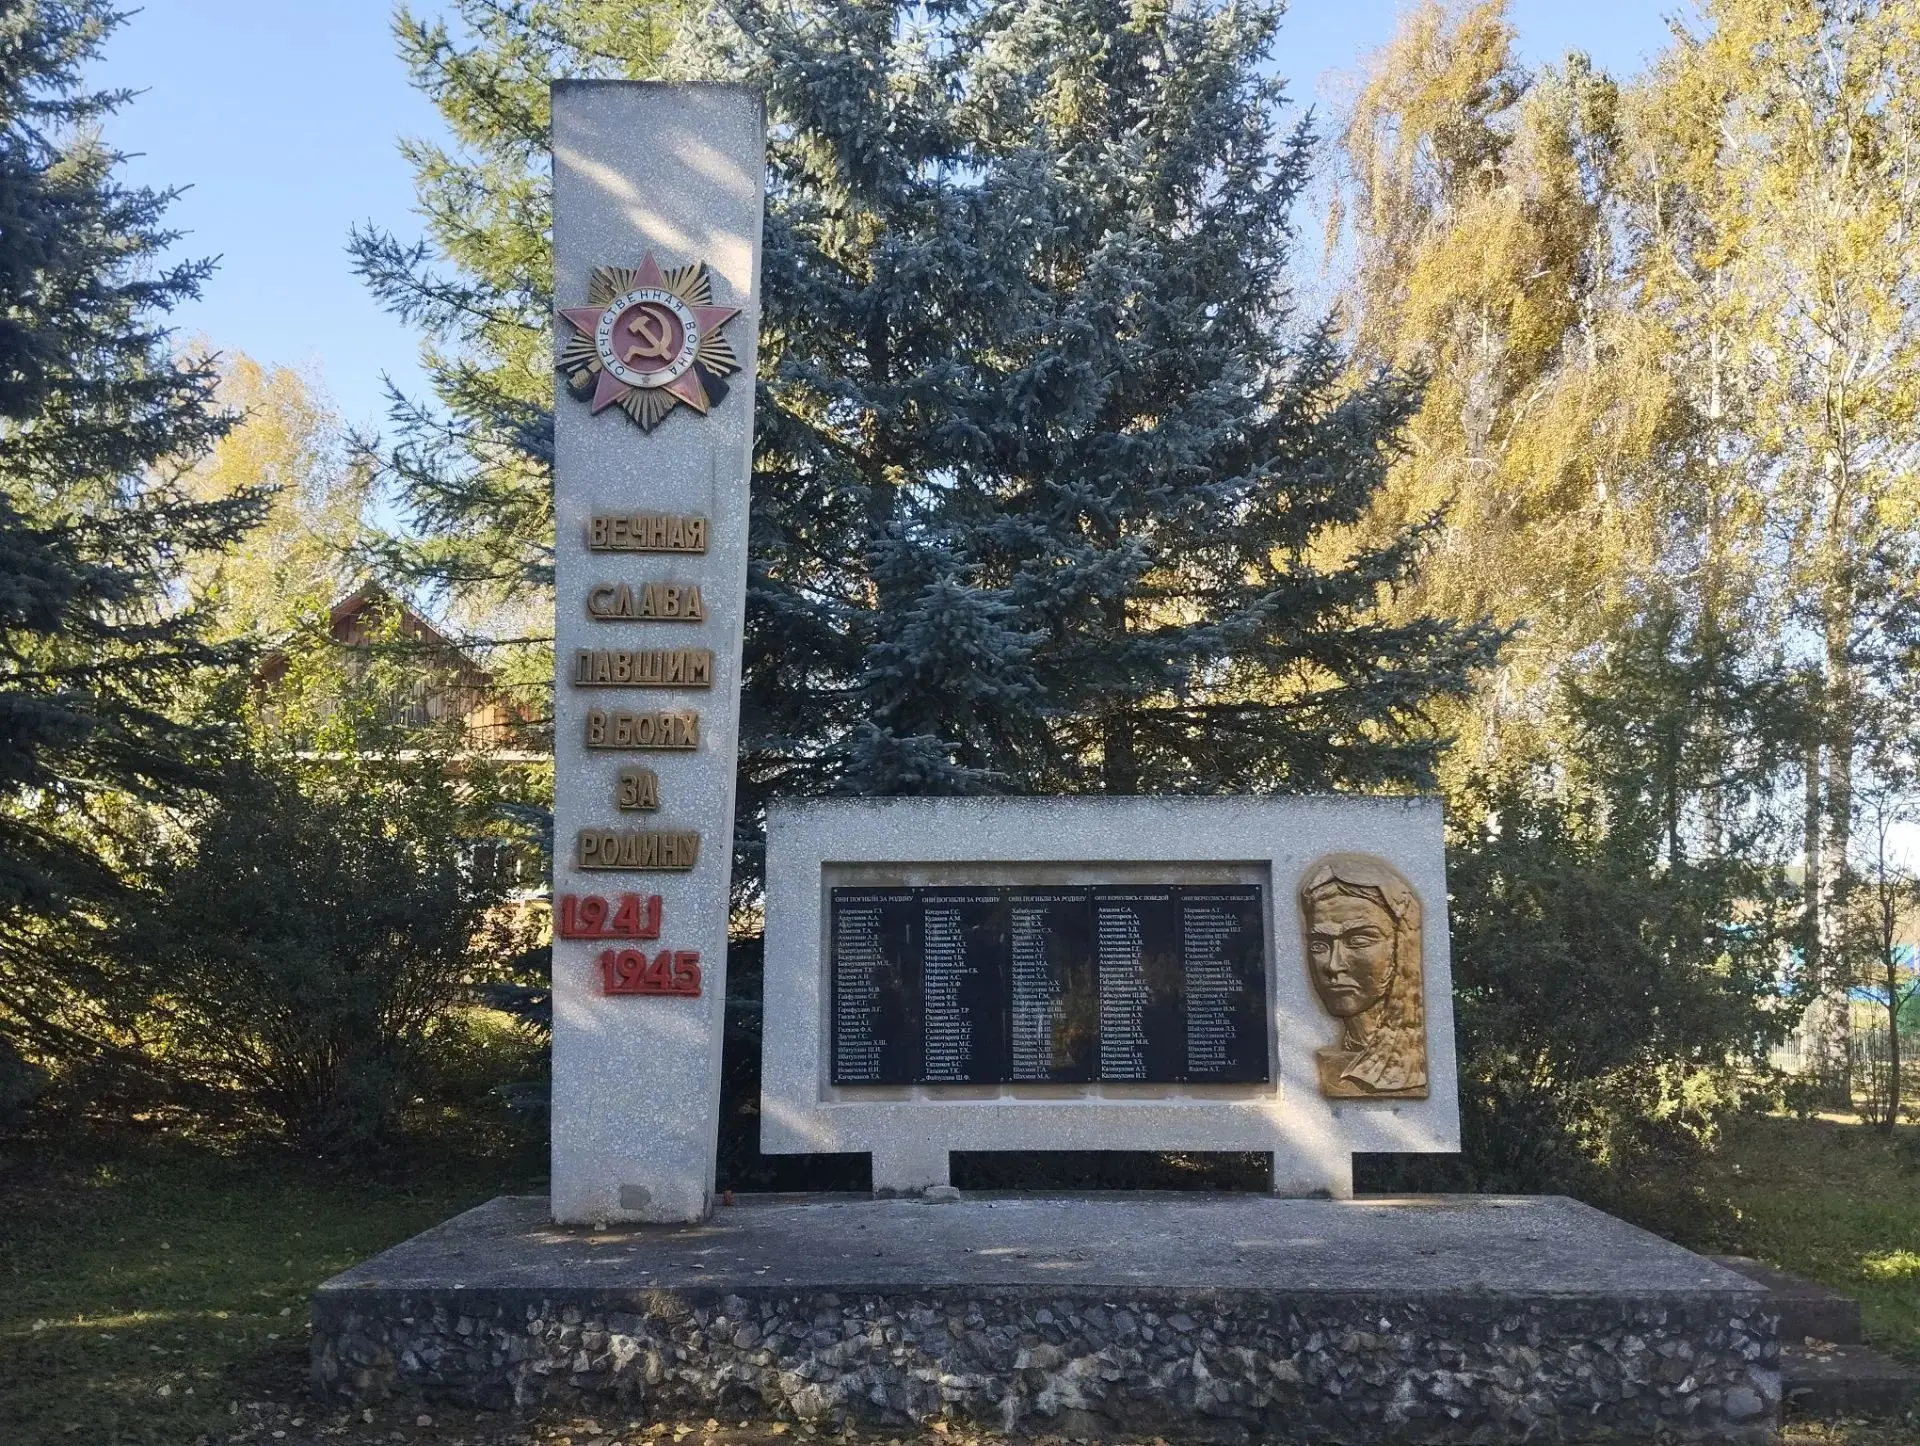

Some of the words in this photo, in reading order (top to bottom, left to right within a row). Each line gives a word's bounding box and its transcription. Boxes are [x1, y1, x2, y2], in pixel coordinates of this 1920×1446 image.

[598, 289, 684, 376] ОТЕЧЕСТВЕННАЯ
[591, 516, 704, 550] ВЕЧНАЯ
[587, 584, 702, 619] СЛАВА
[576, 650, 709, 685] ПАВШИМ
[588, 713, 606, 747] В
[614, 713, 697, 747] БОЯХ
[620, 774, 655, 807] ЗА
[581, 833, 700, 868] РОДИНУ
[562, 896, 660, 937] 1941
[602, 951, 700, 993] 1945
